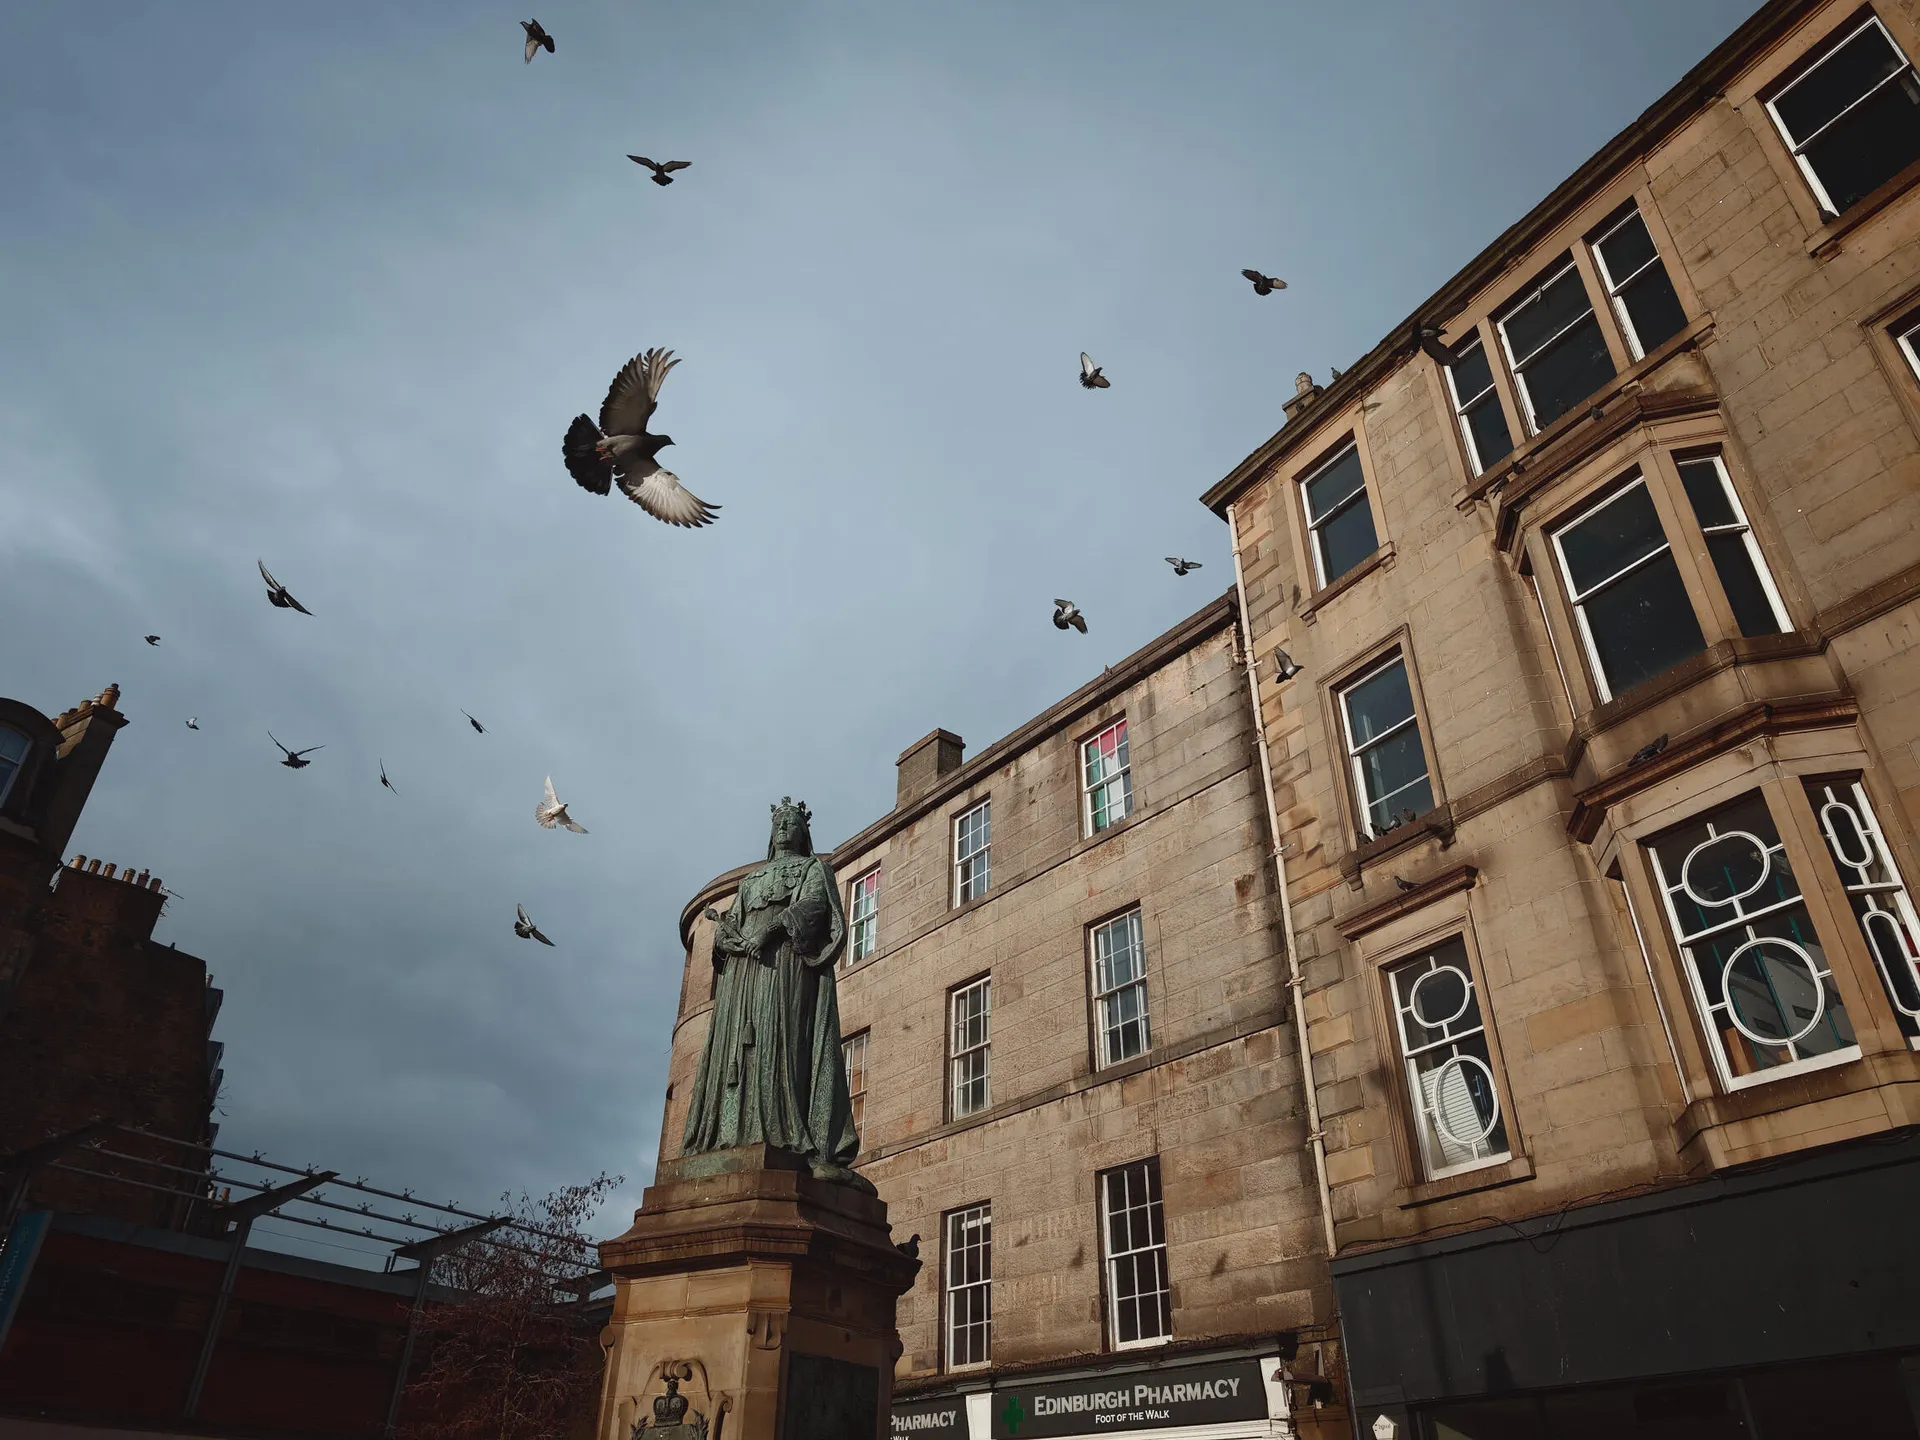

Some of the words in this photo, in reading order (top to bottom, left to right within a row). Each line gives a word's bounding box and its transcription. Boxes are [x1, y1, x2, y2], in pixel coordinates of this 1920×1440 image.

[1034, 1389, 1130, 1416] EDINBURGH
[1134, 1378, 1240, 1406] PHARMACY
[1095, 1414, 1116, 1424] FOOT
[1116, 1413, 1127, 1422] OF
[1128, 1412, 1144, 1421] THE
[1145, 1409, 1170, 1420] WALK
